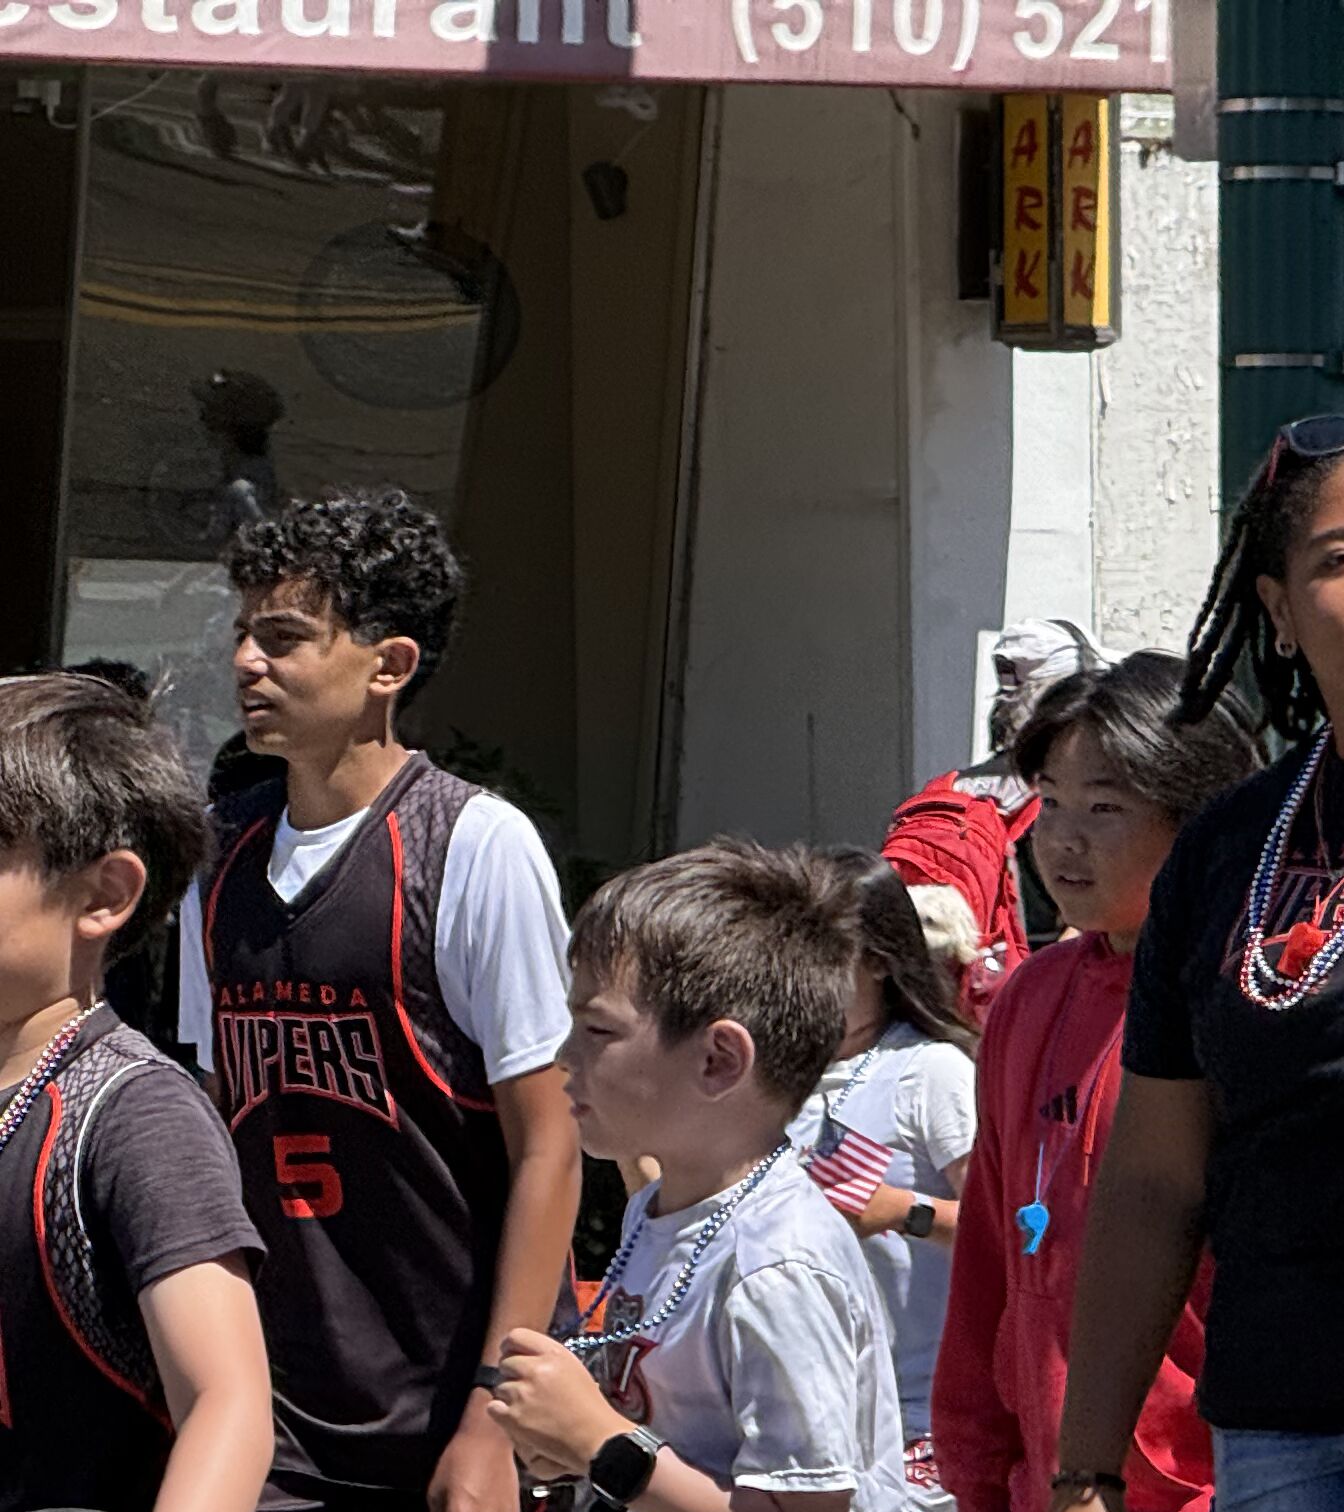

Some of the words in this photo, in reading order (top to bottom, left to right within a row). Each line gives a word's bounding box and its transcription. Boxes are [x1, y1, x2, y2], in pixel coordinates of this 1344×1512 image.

[0, 0, 641, 48] staurant
[731, 0, 980, 71] (510)
[1011, 117, 1043, 299] ARK
[219, 980, 369, 1008] ALAMEDA
[217, 1010, 400, 1133] VIPERS
[272, 1134, 344, 1219] 5
